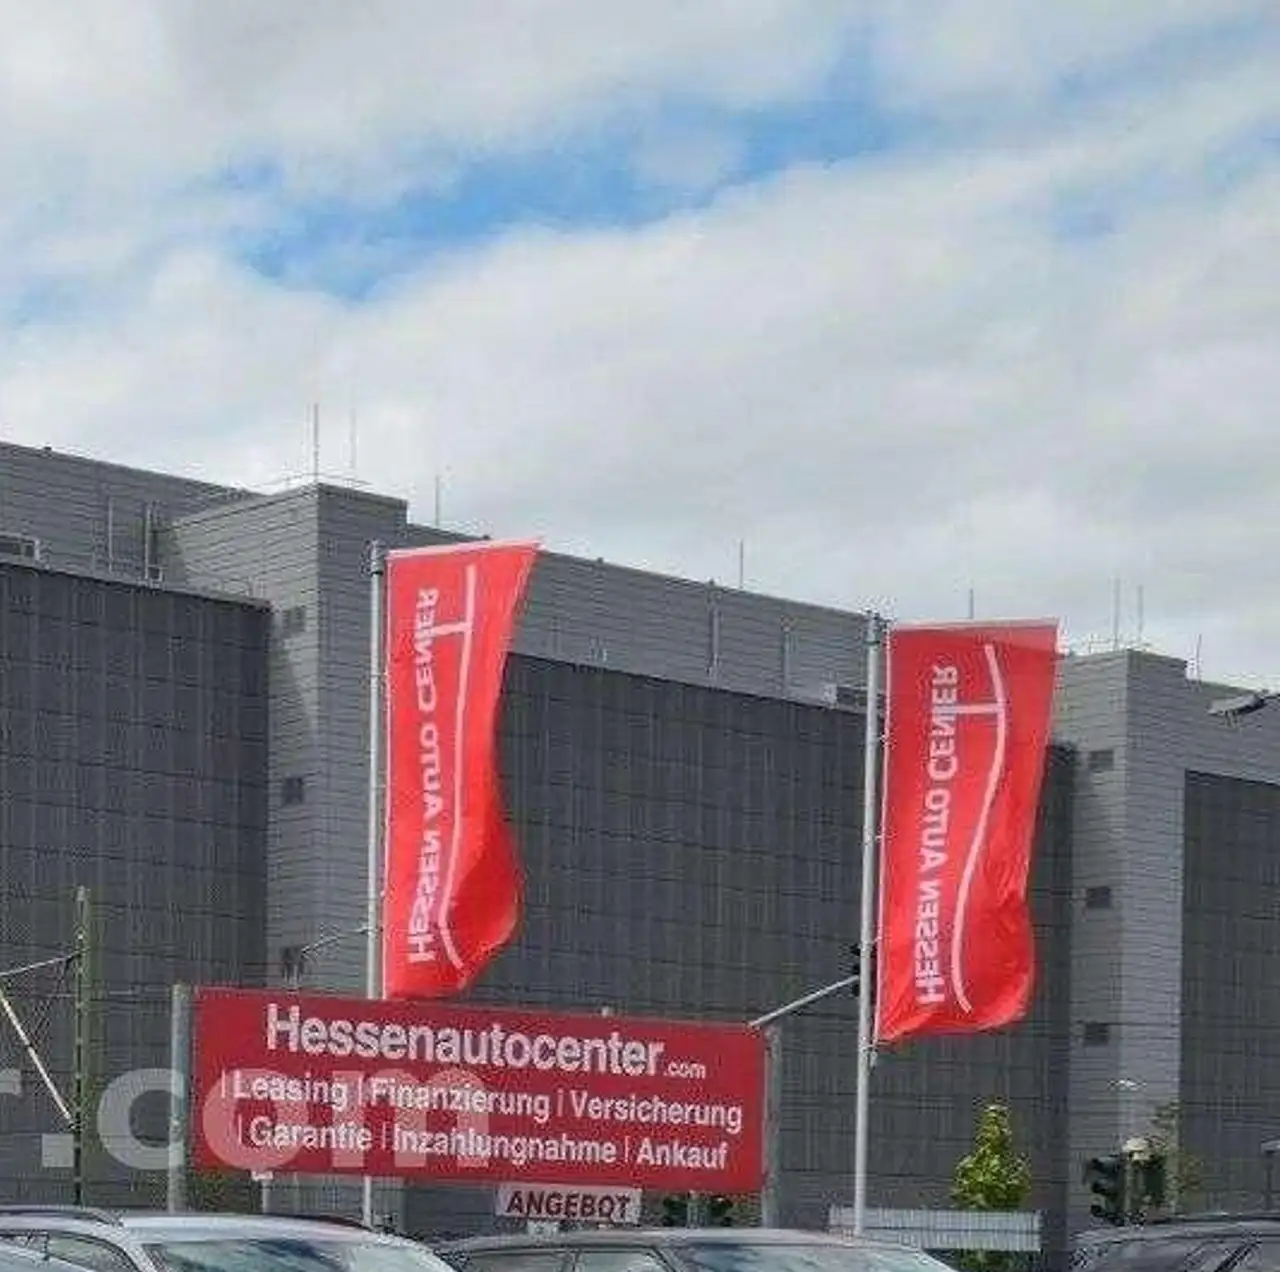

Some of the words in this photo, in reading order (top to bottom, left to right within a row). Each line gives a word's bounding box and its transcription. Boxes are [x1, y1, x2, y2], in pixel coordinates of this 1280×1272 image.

[233, 1069, 349, 1111] Leasing
[370, 1076, 550, 1123] Finanzierung
[570, 1089, 743, 1135] Versicherung
[248, 1115, 373, 1152] Garantie
[636, 1135, 729, 1170] Ankauf
[505, 1189, 632, 1219] ANGEBOT
